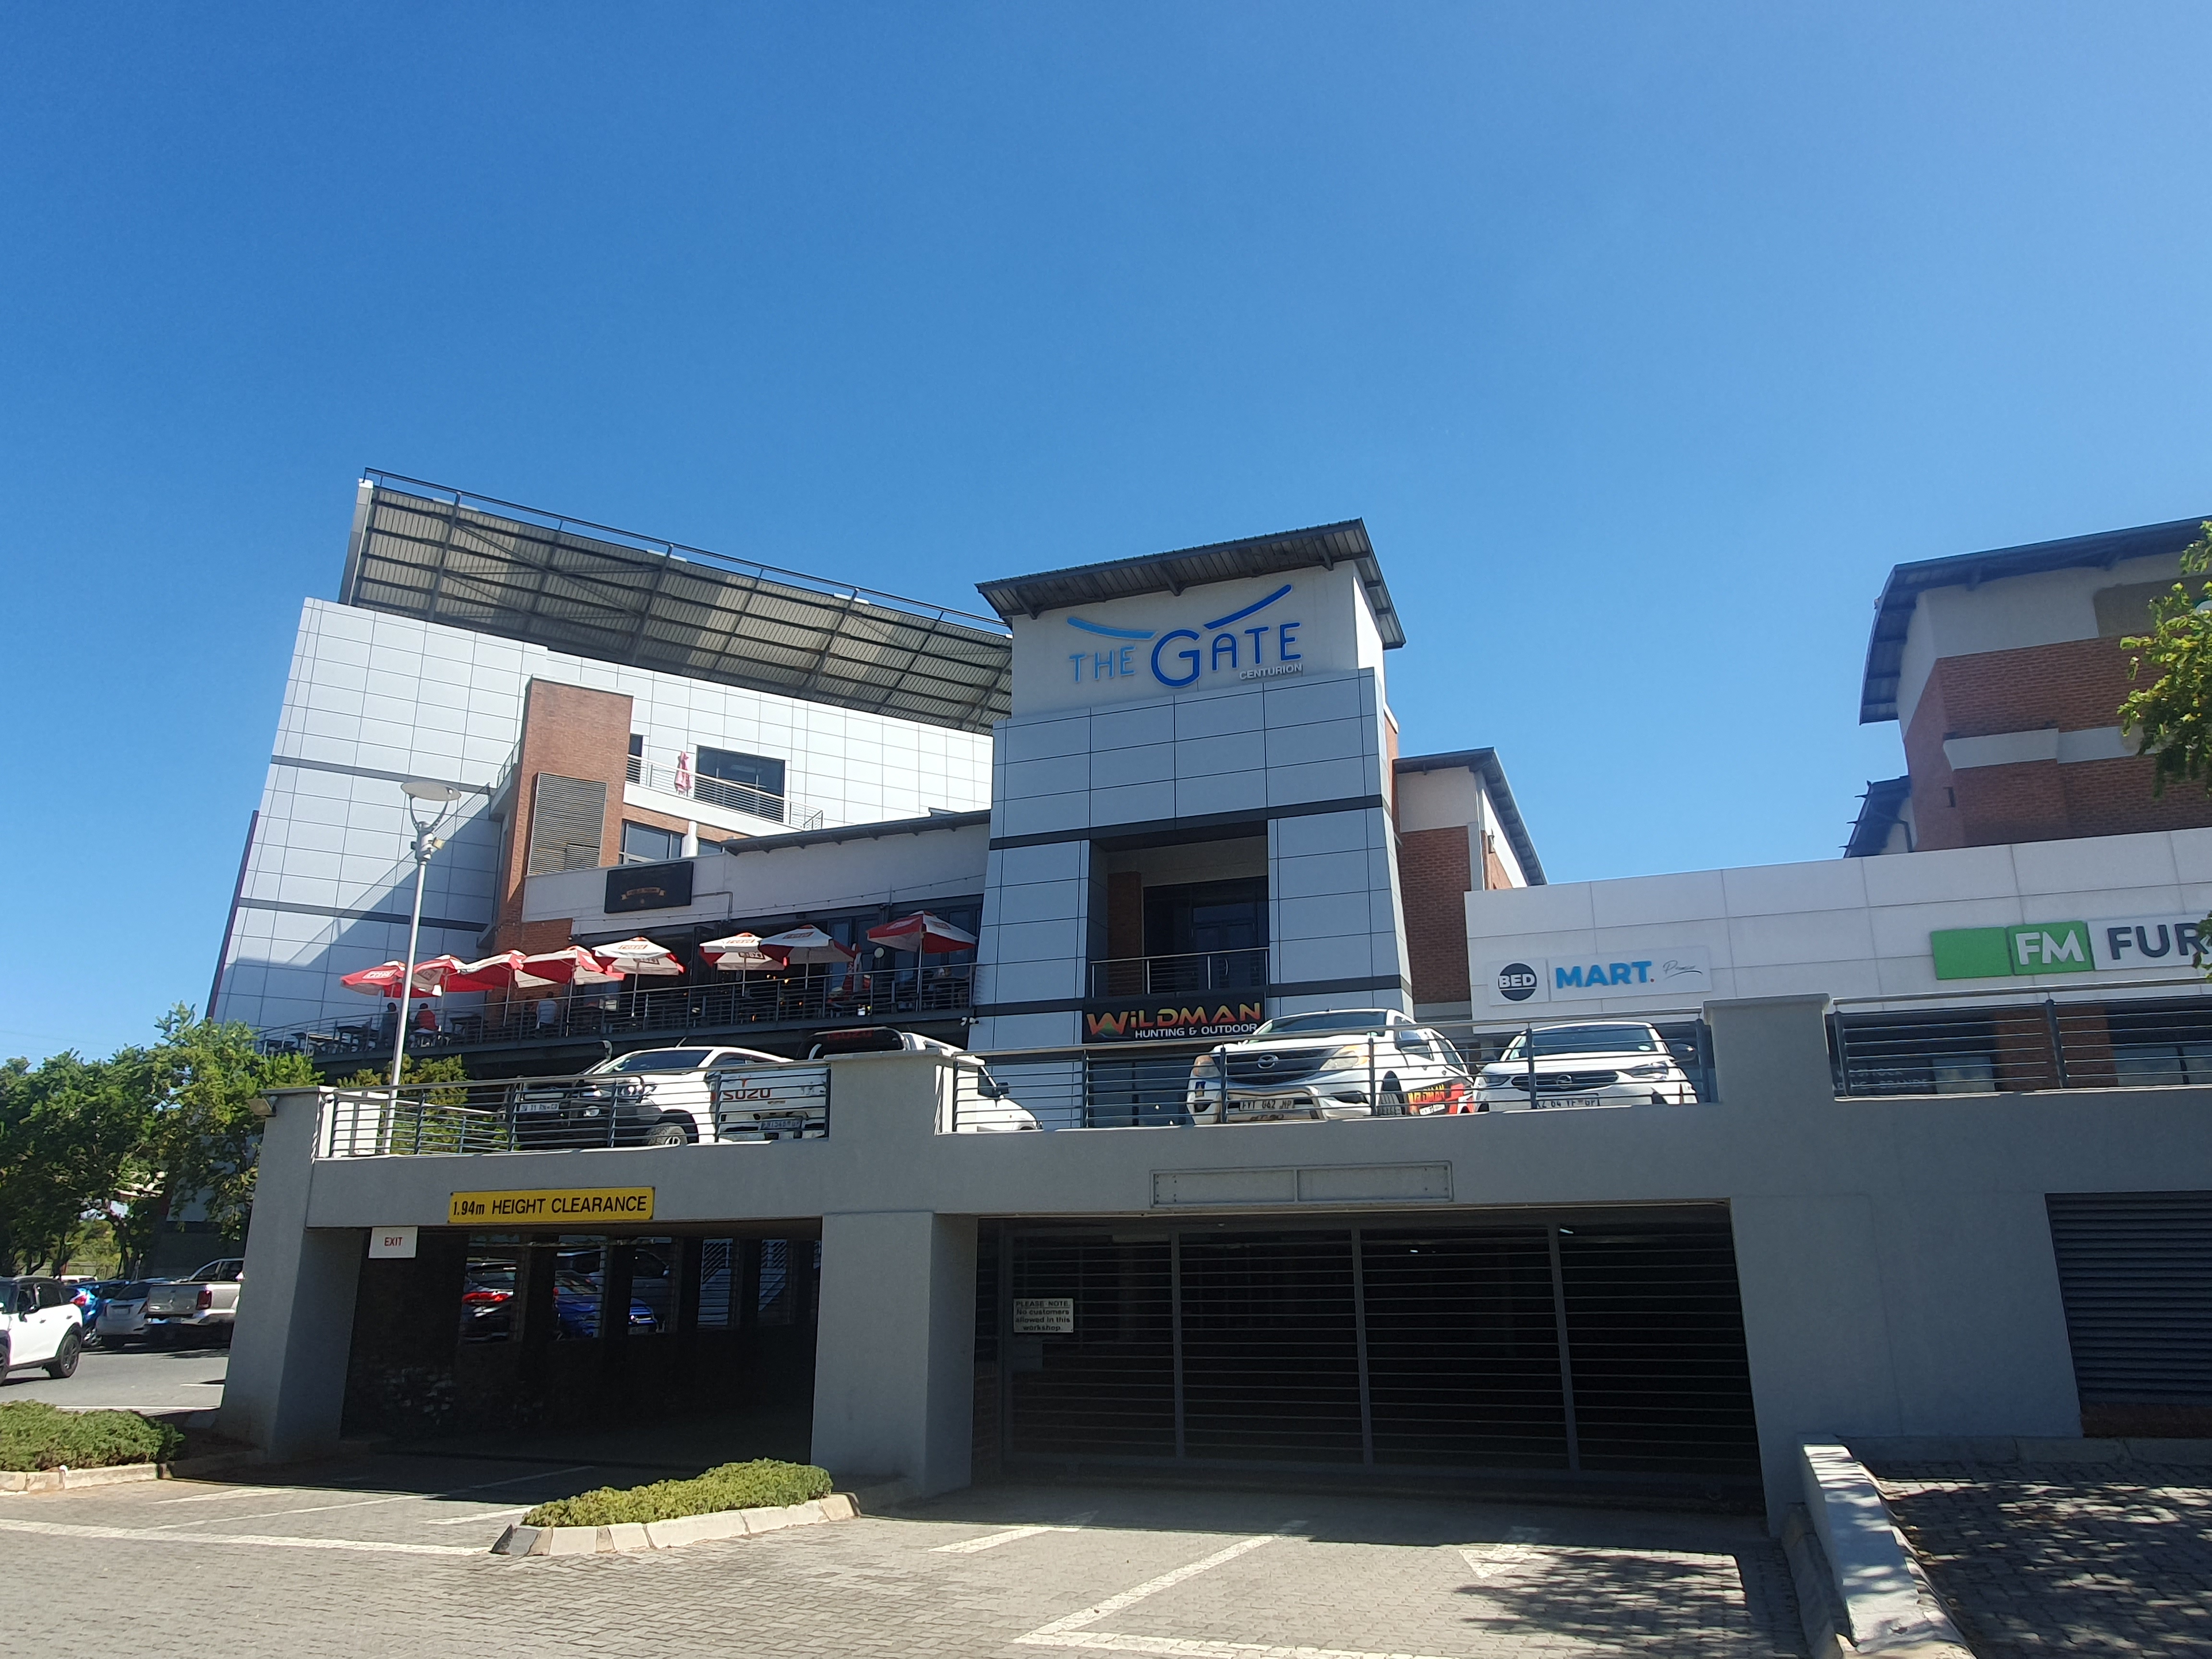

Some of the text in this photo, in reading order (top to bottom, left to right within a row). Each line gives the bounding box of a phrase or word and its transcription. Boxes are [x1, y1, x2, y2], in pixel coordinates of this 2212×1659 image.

[1069, 622, 1302, 688] THE GATE
[1239, 663, 1302, 680] CENTURION
[2015, 929, 2086, 965] FM
[1498, 974, 1535, 987] BED
[1135, 1027, 1185, 1038] HUNTING
[1189, 1027, 1198, 1035] &
[453, 1195, 647, 1216] 1.94m HEIGHT CLEARANCE
[384, 1236, 403, 1247] EXIT
